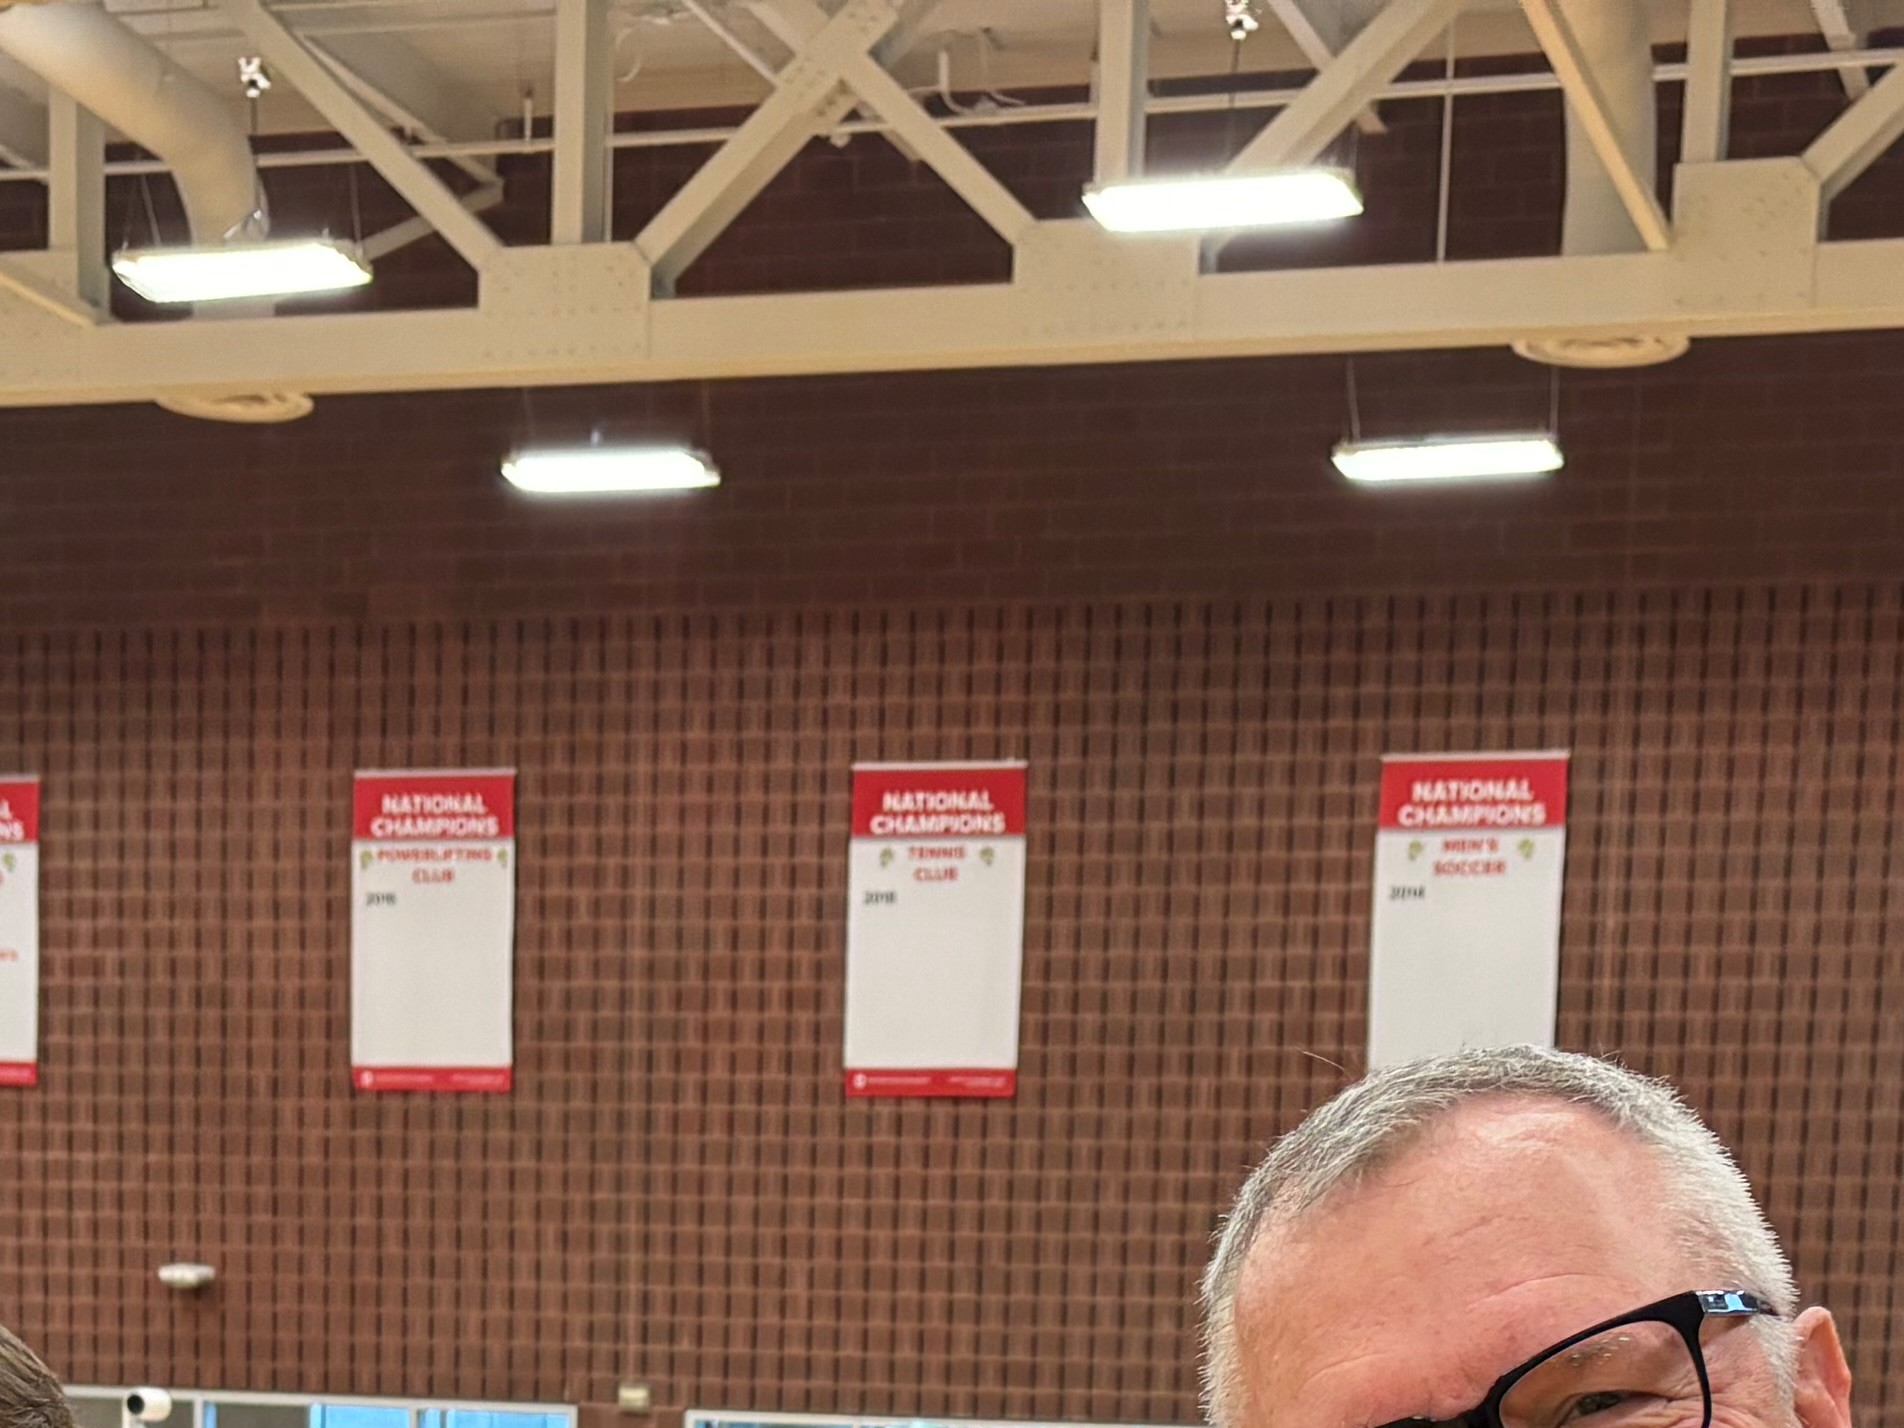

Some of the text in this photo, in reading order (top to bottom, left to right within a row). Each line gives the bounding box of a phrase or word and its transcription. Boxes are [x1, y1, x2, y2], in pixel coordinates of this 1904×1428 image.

[882, 790, 994, 812] NATIONAL
[1411, 779, 1535, 803] NATIONAL
[381, 793, 488, 815] NATIONAL
[1397, 803, 1546, 827] CHAMPIONS
[370, 815, 499, 838] CHAMPIONS
[869, 813, 1006, 835] CHAMPIONS
[907, 846, 966, 859] TENNIS
[1442, 838, 1498, 853] MEN'S
[411, 868, 456, 884] CLUB
[913, 867, 958, 882] CLUB
[1432, 861, 1506, 876] SOCCER
